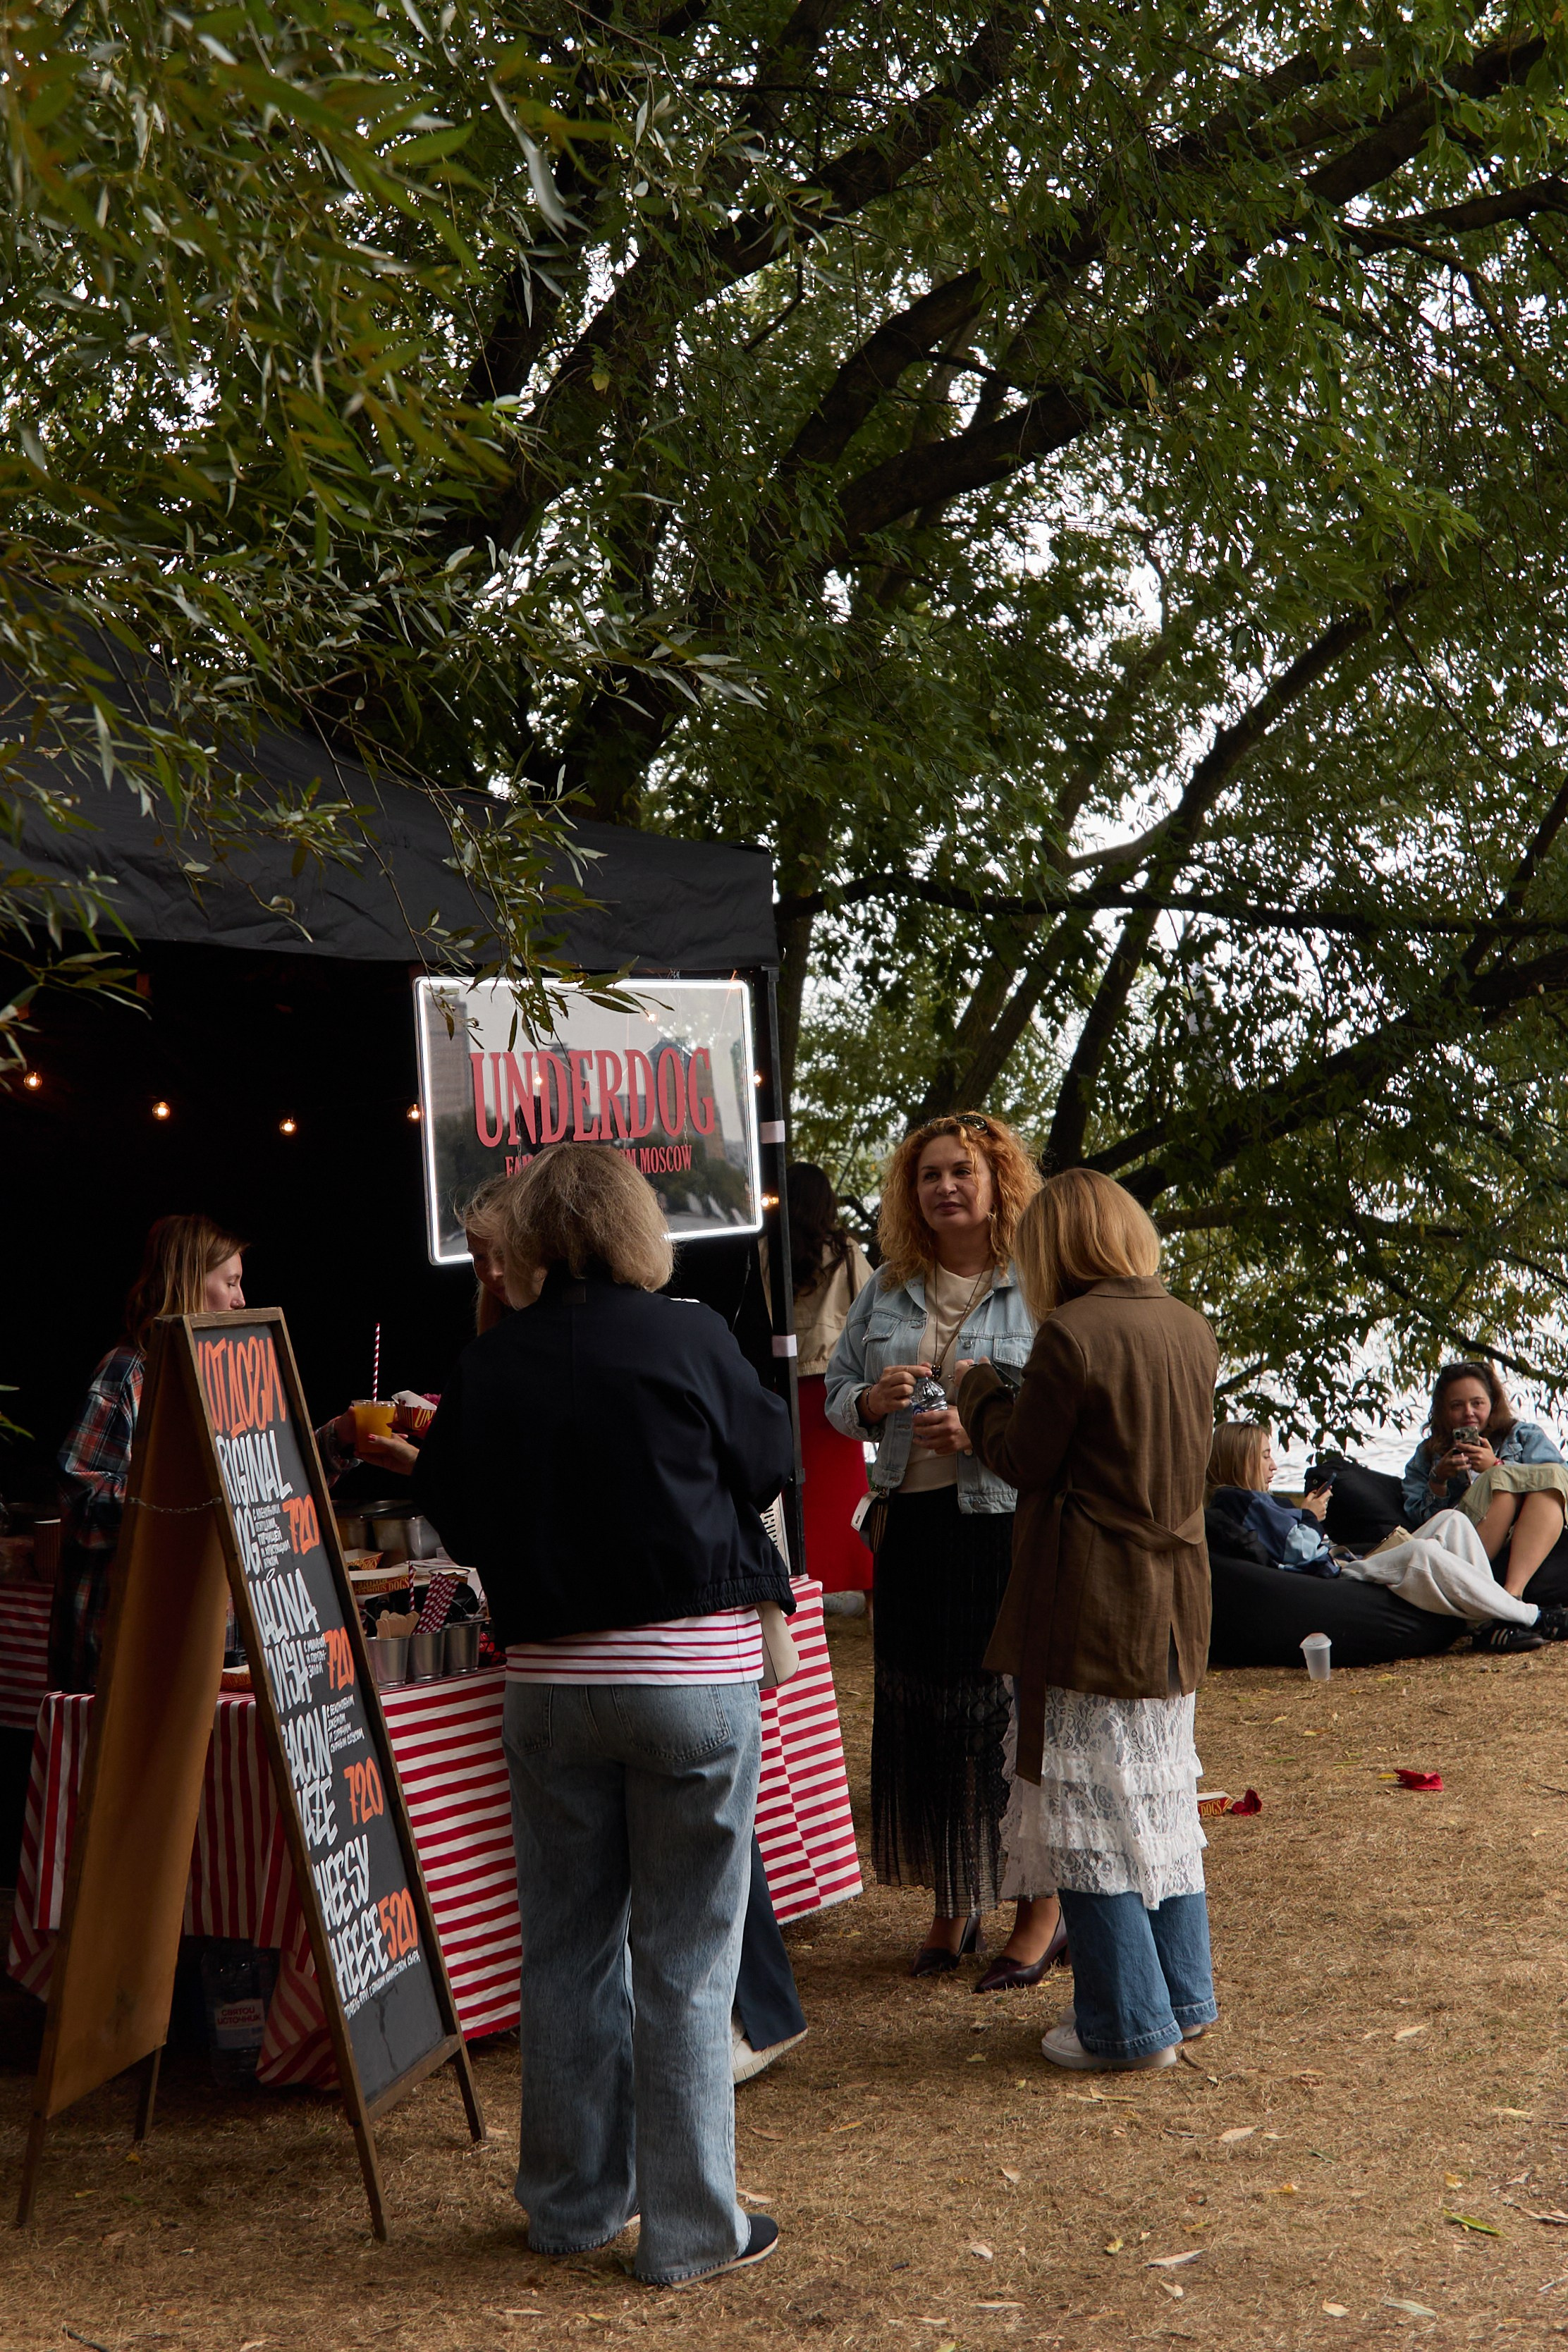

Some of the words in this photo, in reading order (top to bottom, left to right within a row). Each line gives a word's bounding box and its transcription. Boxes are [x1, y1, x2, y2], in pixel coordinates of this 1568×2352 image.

[469, 1047, 715, 1147] UNDERDOG
[639, 1145, 692, 1174] MOSCOW
[216, 1430, 293, 1507] RIGINAL
[233, 1506, 264, 1575] OG
[282, 1494, 319, 1555] 720
[249, 1568, 320, 1647] ALINA
[388, 1576, 409, 1591] DOGS
[324, 1627, 355, 1691] 720
[297, 1775, 338, 1851] AZE
[343, 1756, 384, 1825] 720
[1201, 1800, 1222, 1817] DOGS
[312, 1834, 369, 1930] HEESY
[328, 1903, 388, 2002] HEESE
[378, 1887, 418, 1961] 520
